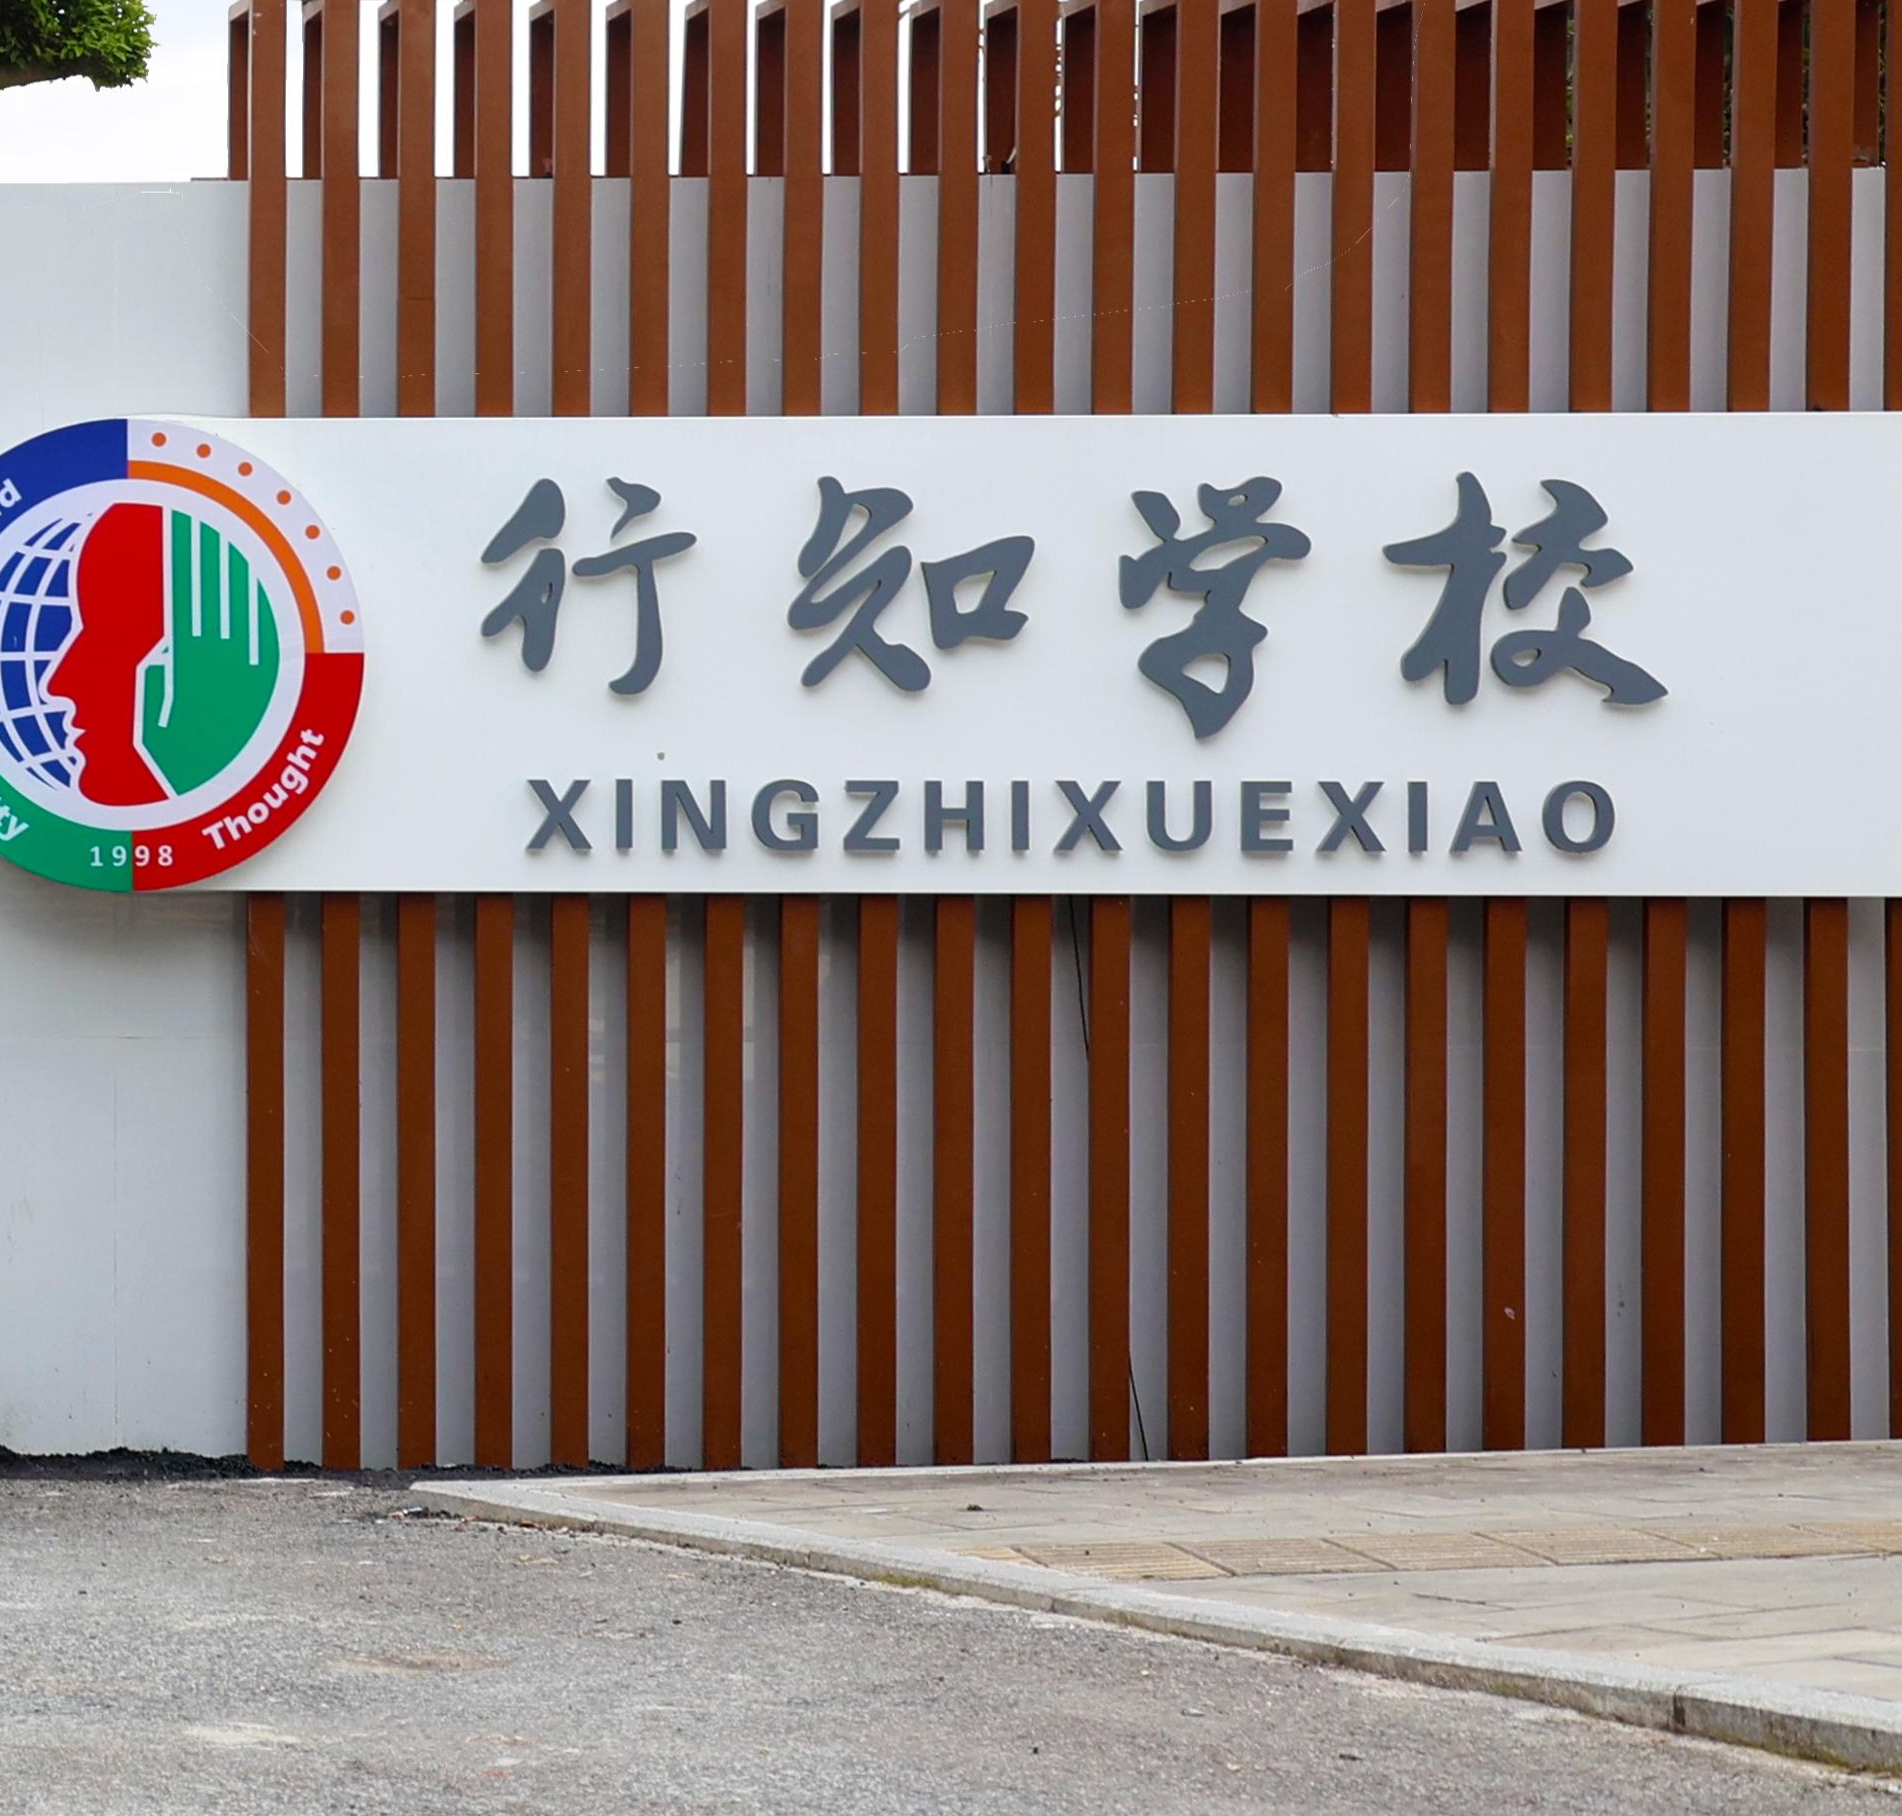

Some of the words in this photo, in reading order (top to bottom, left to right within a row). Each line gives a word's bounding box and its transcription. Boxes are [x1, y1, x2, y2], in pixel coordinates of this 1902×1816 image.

[481, 470, 1670, 744] 行知学校
[201, 726, 326, 851] Thought
[526, 778, 1618, 860] XINGZHIXUEXIAO
[89, 845, 174, 868] 1998
